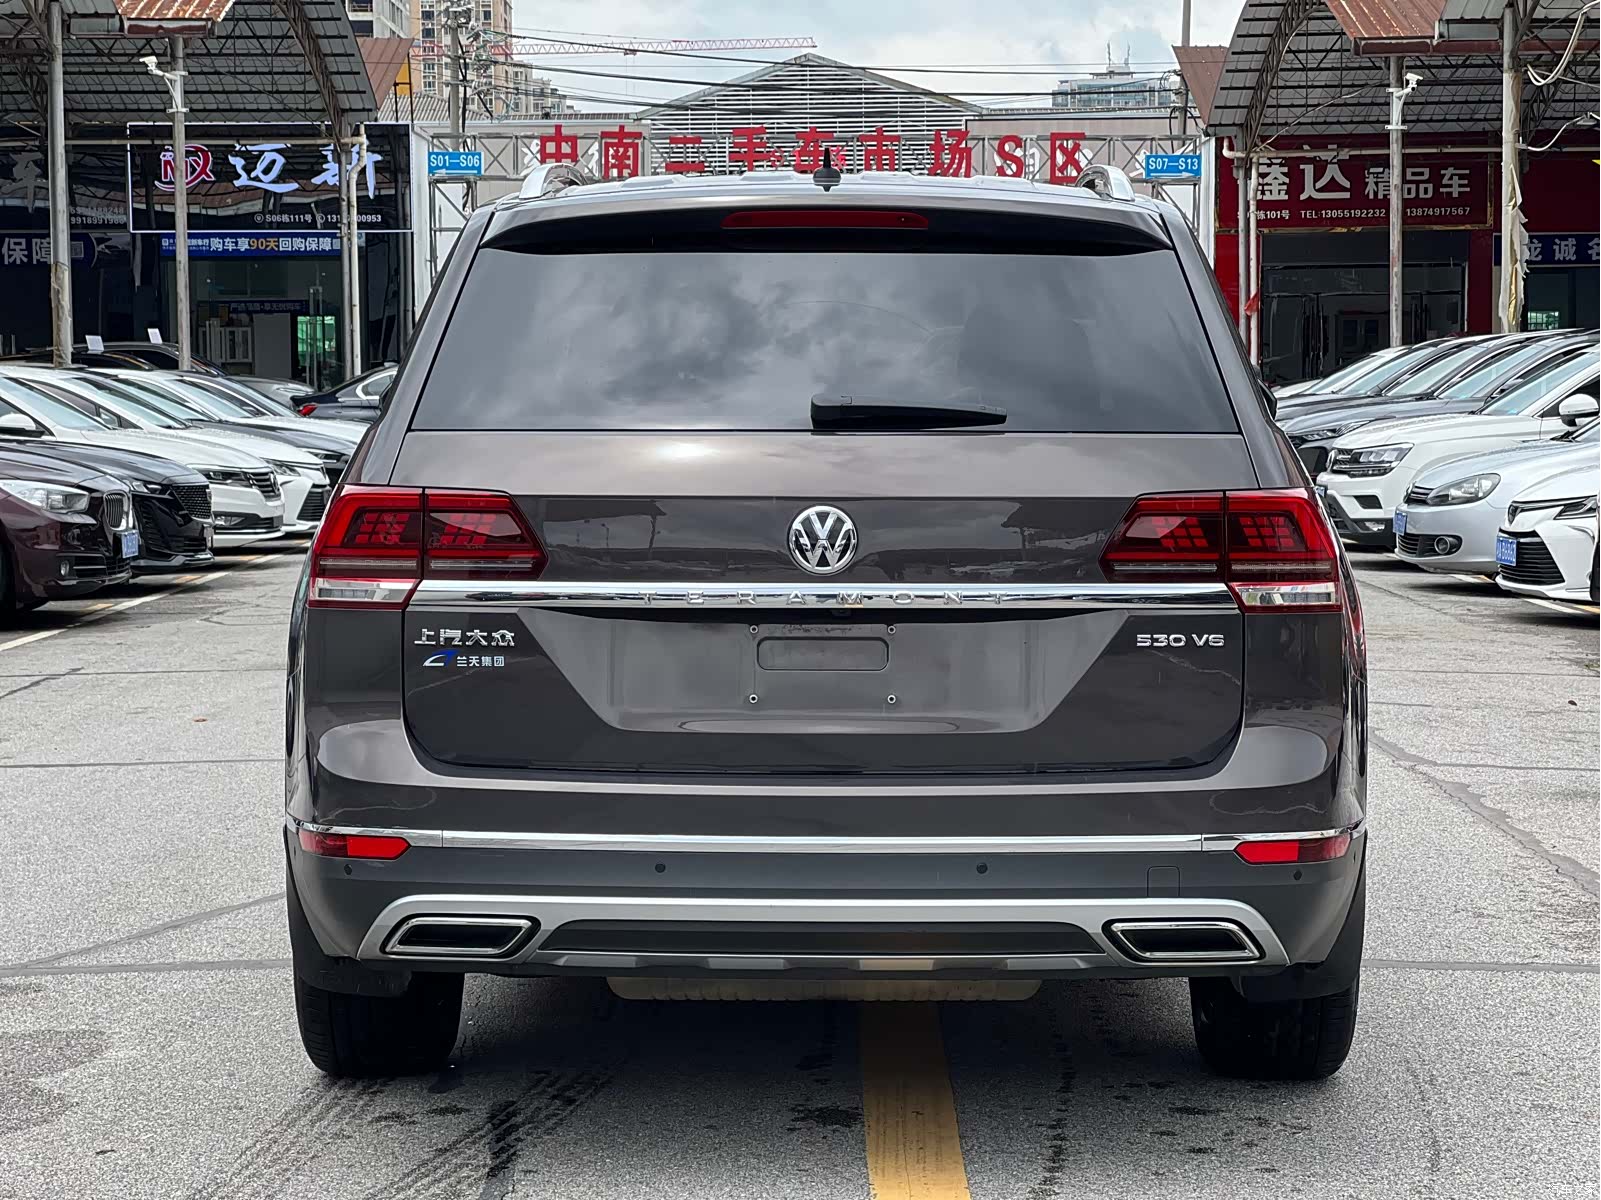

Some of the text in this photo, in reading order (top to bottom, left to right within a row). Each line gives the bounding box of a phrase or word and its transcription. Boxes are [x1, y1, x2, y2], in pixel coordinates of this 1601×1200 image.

[228, 140, 384, 199] 迈新
[1364, 166, 1471, 199] 精品车
[326, 213, 382, 223] 13100953
[1238, 207, 1471, 220] 栋101号 TEL:13055192232 13874917567
[210, 237, 333, 252] 购车享90天回购保障
[638, 590, 1008, 606] TERAMONT
[414, 628, 515, 647] 上汽大众
[1136, 634, 1225, 647] 530 V6
[456, 655, 505, 667] 兰天集团
